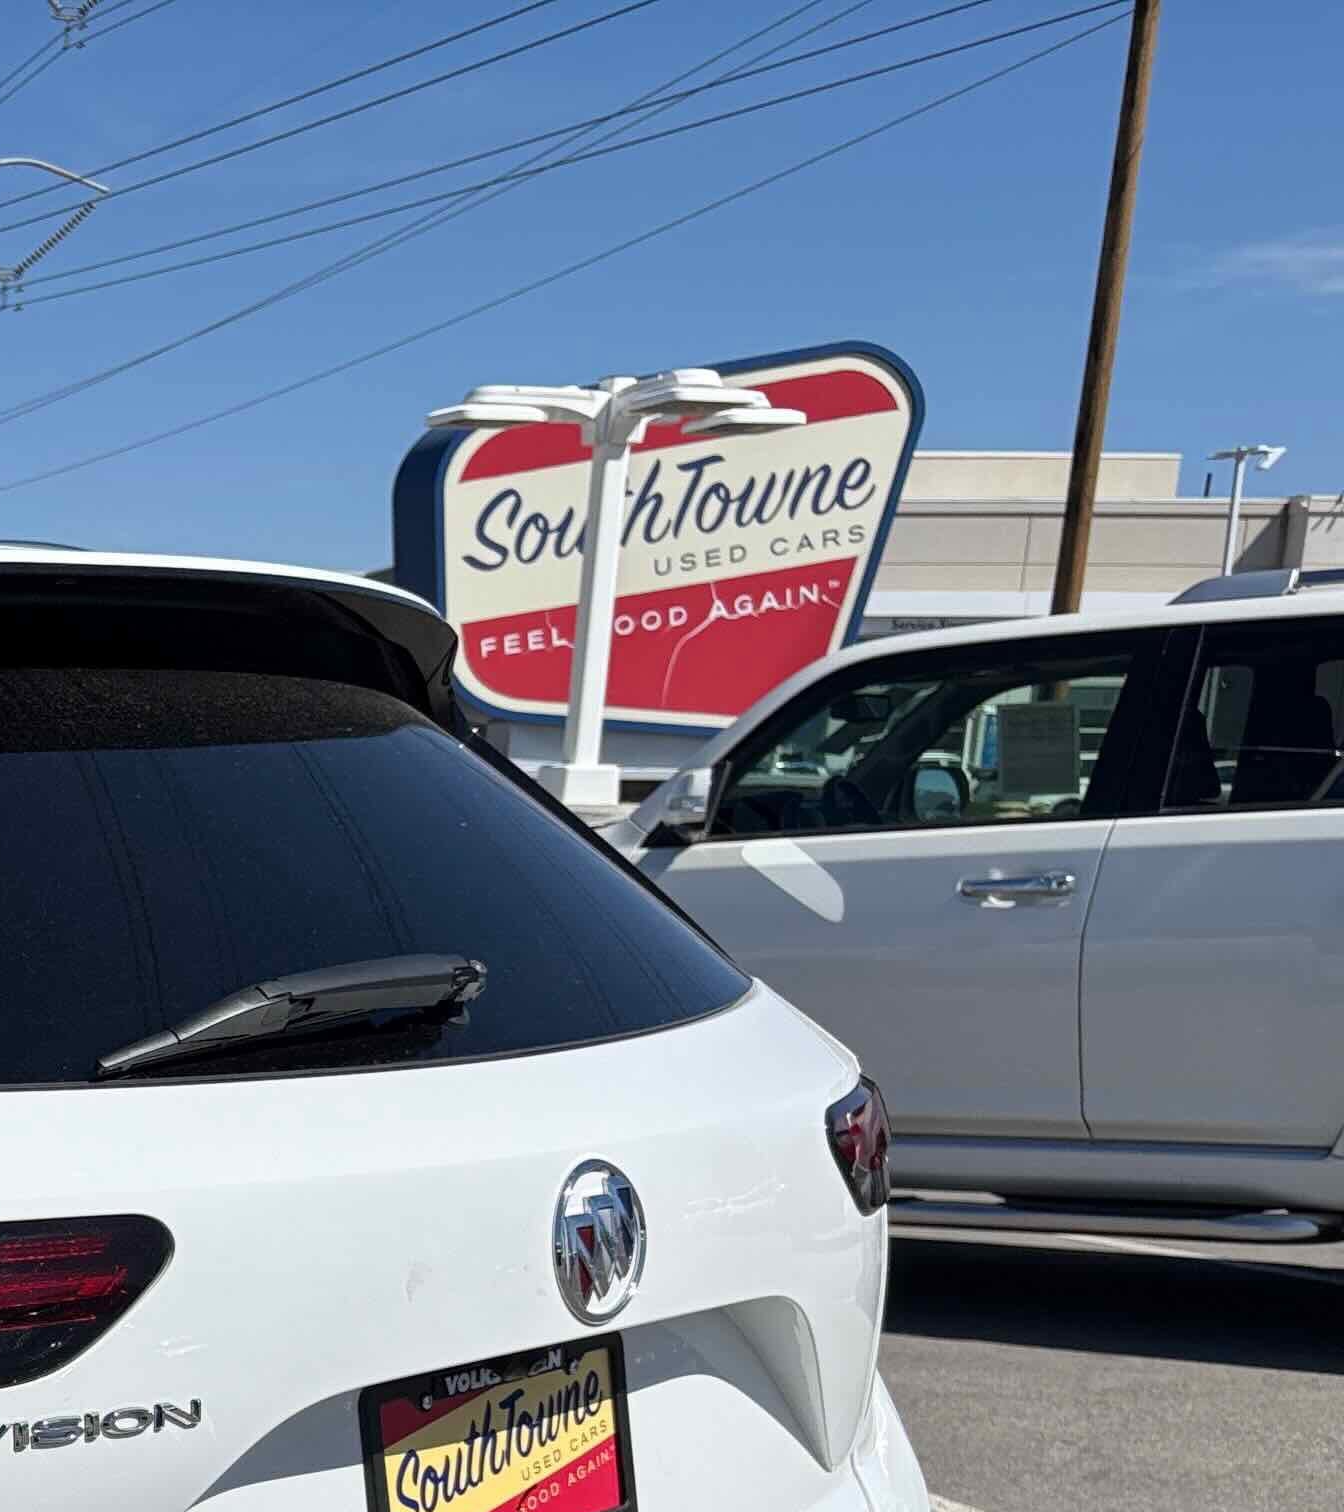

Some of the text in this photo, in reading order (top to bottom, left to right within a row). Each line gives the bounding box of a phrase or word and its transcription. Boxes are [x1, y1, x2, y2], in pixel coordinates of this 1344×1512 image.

[461, 453, 877, 573] SouhTowne
[652, 524, 867, 577] USED CARS
[479, 626, 569, 658] FEEL
[614, 604, 689, 636] OOD
[520, 1419, 609, 1481] USED CARS
